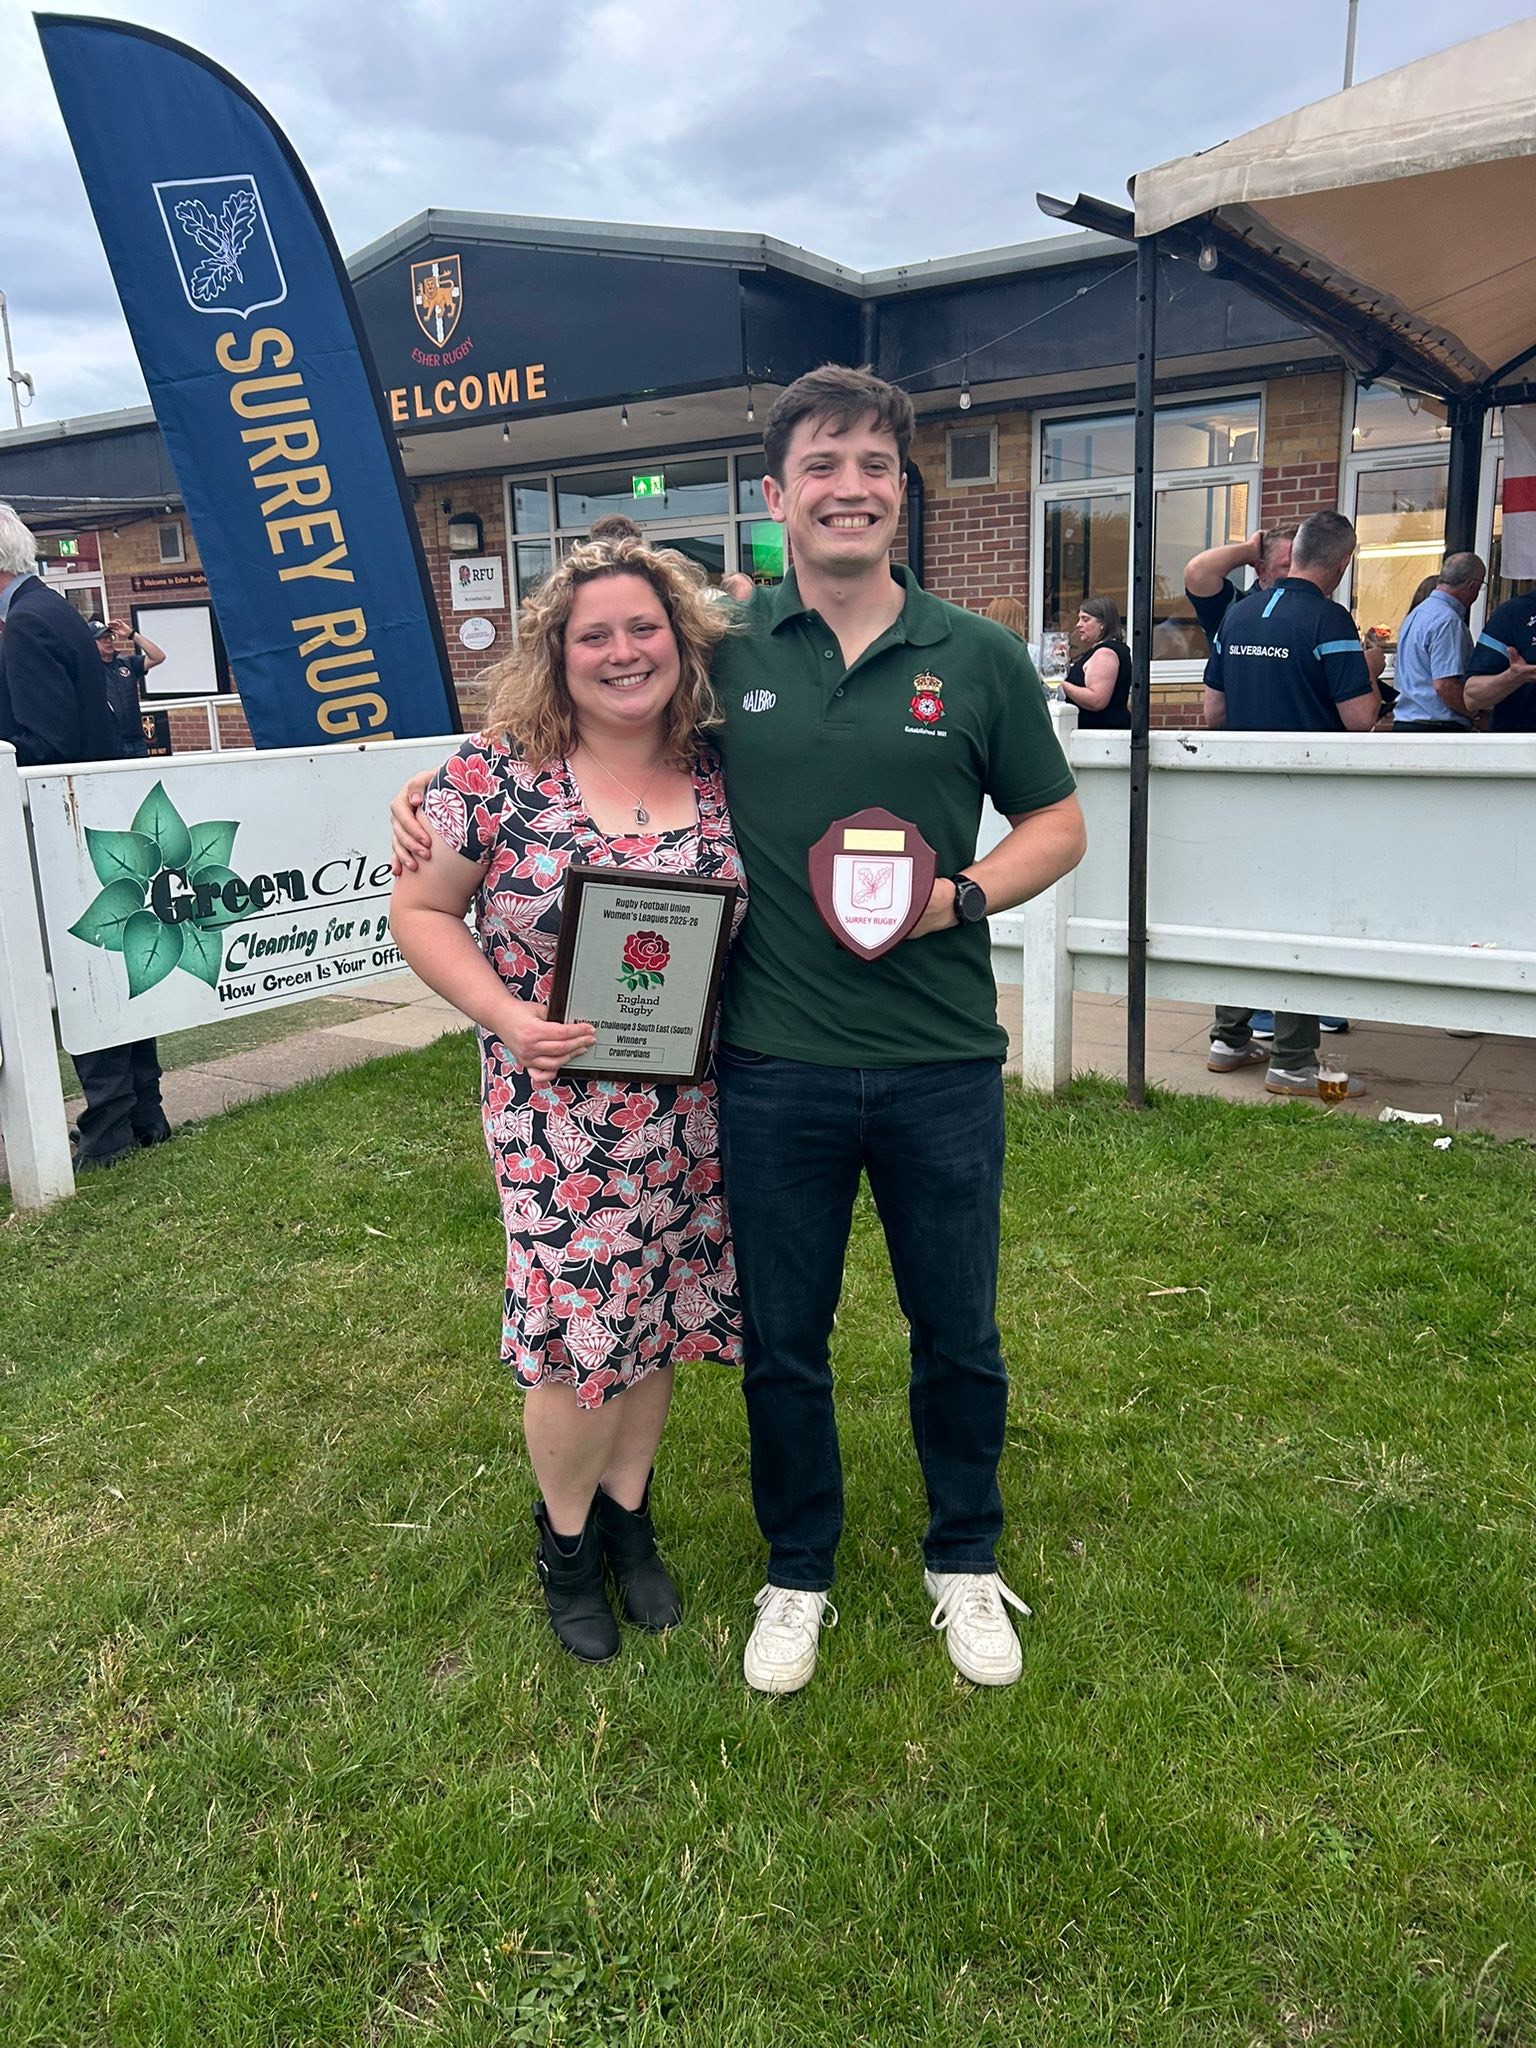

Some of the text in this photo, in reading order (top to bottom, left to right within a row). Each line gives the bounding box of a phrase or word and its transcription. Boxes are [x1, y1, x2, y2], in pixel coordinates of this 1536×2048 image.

[411, 335, 475, 367] ESHER RUGBY
[384, 364, 547, 422] ELCOME
[215, 327, 395, 745] SURREY RUG
[143, 577, 167, 587] Welcome
[472, 567, 494, 581] RFU
[1228, 644, 1290, 659] SILVERBACKS
[742, 689, 777, 712] HALBRO
[615, 897, 691, 914] Rugby Football Union
[603, 909, 699, 927] Women's Leagues 2025-26
[844, 916, 898, 926] SURREY RUGBY
[224, 915, 391, 973] Cleaning for a g
[217, 982, 256, 1002] How
[263, 964, 312, 992] Green
[316, 963, 332, 980] Is
[333, 957, 367, 976] Your
[616, 993, 660, 1006] England
[619, 1004, 654, 1017] Rugby
[600, 1020, 632, 1032] Challenge
[632, 1022, 637, 1031] 3
[637, 1022, 656, 1033] South
[656, 1024, 670, 1034] East
[670, 1025, 694, 1036] (South)
[616, 1035, 648, 1046] Winners
[608, 1047, 651, 1059] Cranfordians
